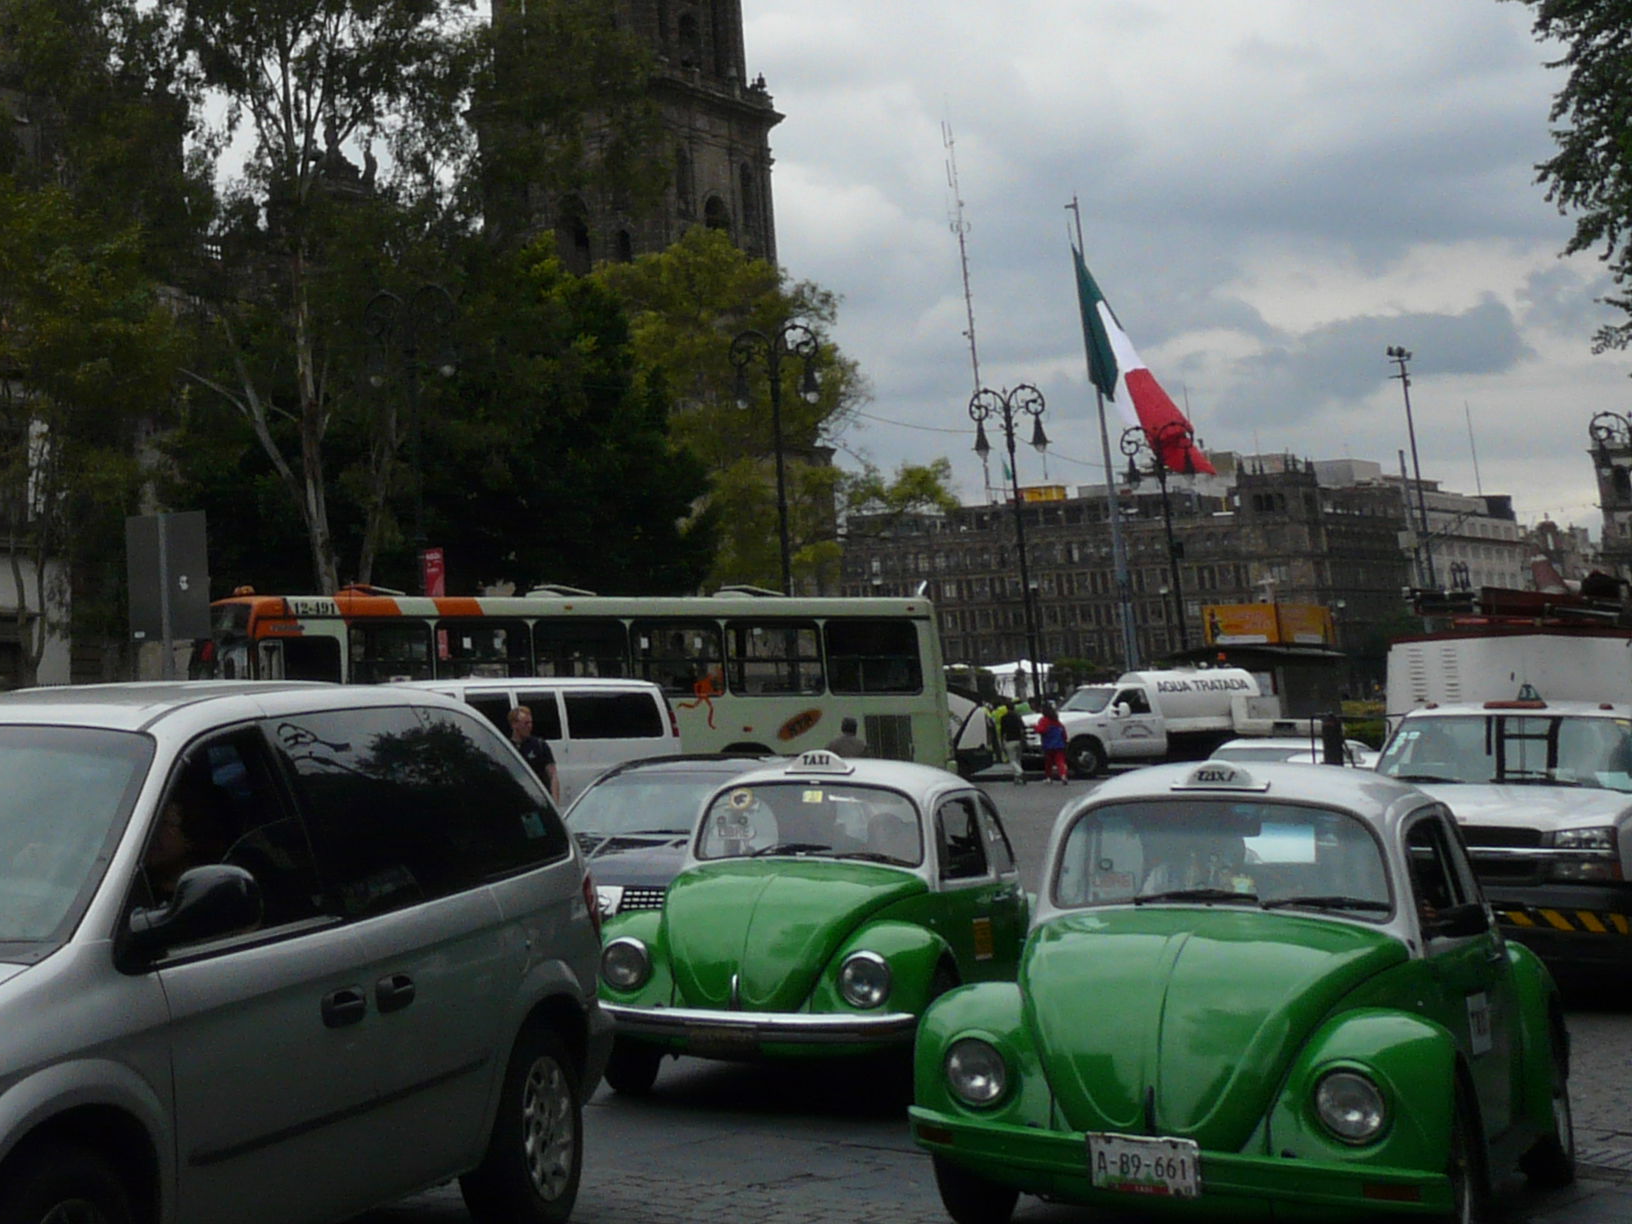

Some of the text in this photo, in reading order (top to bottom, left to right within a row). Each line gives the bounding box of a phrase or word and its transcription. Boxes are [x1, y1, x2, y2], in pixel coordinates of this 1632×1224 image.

[293, 602, 335, 616] 12-491
[1157, 678, 1250, 693] AGUA TRATADA
[803, 755, 829, 765] TAXI
[1197, 771, 1235, 782] TAXI
[1098, 1151, 1187, 1181] A-89-661
